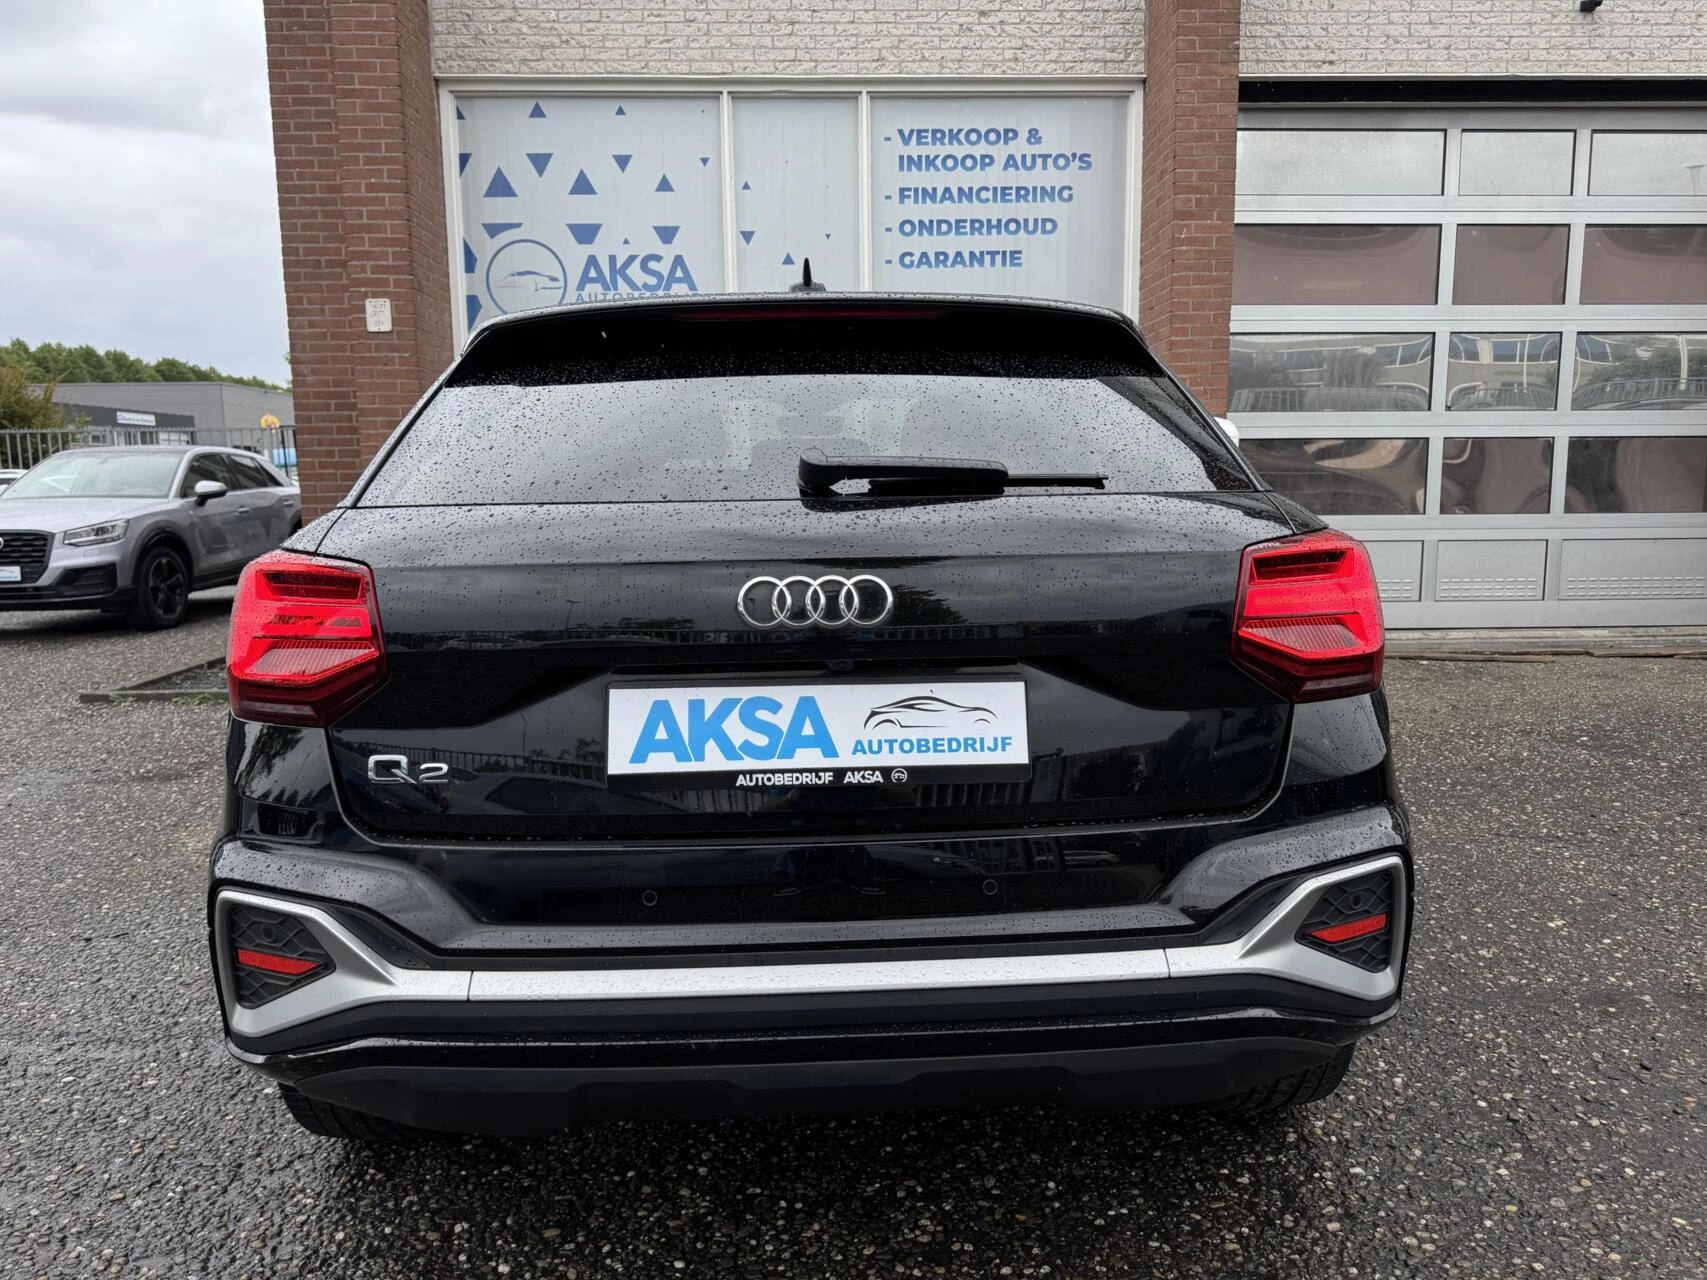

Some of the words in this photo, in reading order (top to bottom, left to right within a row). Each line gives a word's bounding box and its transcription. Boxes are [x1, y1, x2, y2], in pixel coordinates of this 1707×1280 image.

[897, 127, 1019, 147] VERKOOP
[1025, 127, 1043, 146] &
[898, 153, 995, 173] INKOOP
[1002, 152, 1093, 172] AUTO'S
[898, 185, 1074, 205] FINANCIERING
[898, 217, 1058, 238] ONDERHOUD
[898, 249, 1023, 269] GARANTIE
[575, 253, 698, 292] AKSA
[628, 695, 840, 764] AKSA
[851, 736, 1013, 756] AUTOBEDRIJF
[367, 754, 449, 784] Q2
[735, 772, 834, 787] AUTOBEDRIJF
[843, 770, 884, 784] AKSA
